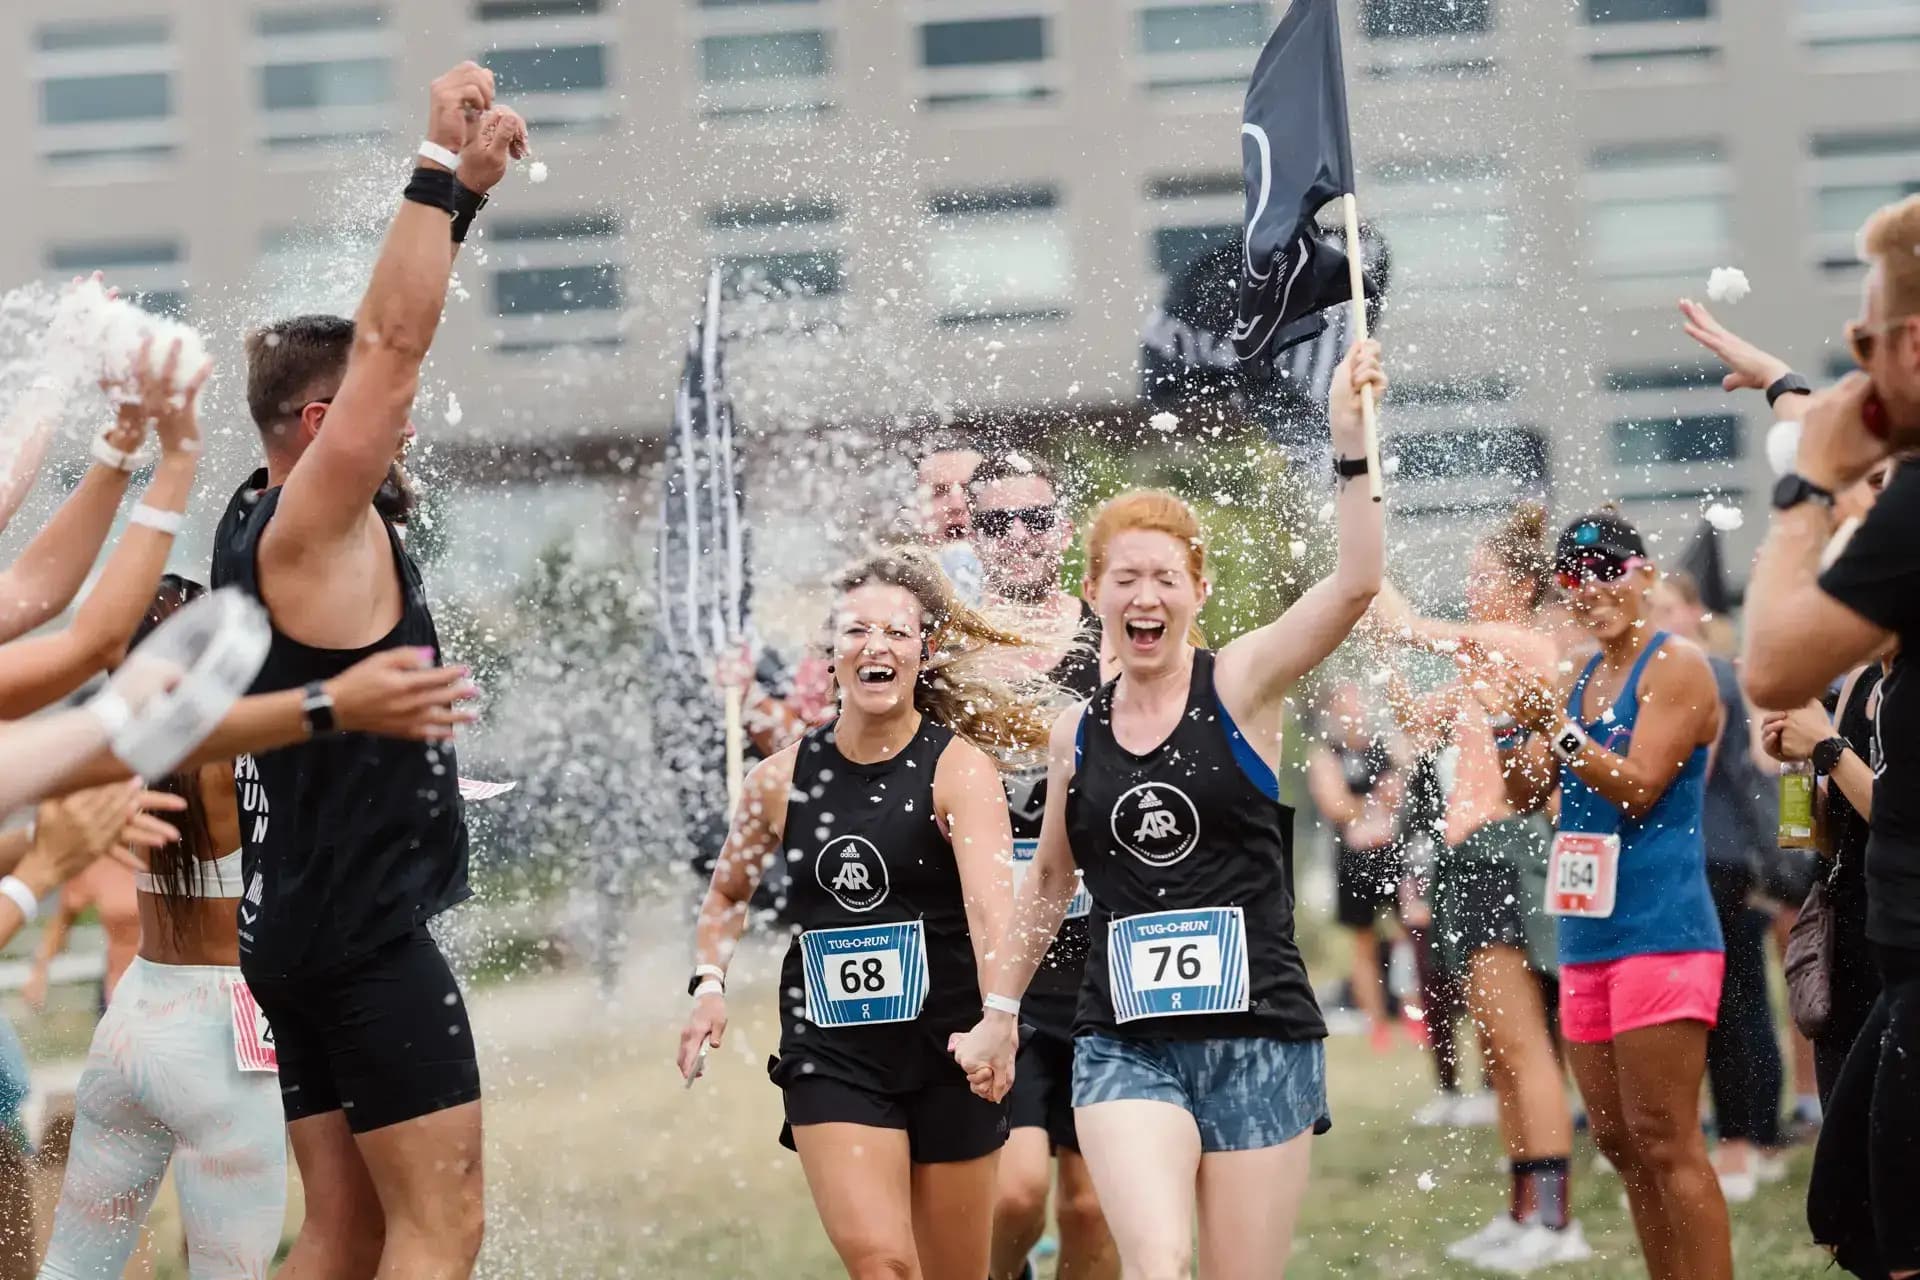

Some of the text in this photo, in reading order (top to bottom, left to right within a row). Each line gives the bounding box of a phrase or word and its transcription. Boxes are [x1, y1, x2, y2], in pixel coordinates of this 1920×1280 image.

[1133, 809, 1182, 842] AR
[831, 862, 874, 890] AR
[1561, 861, 1593, 888] 164
[1137, 920, 1209, 936] TUG-O-RUN
[828, 935, 890, 950] TUG-O-RUN
[840, 958, 885, 993] 68
[1148, 944, 1201, 982] 76
